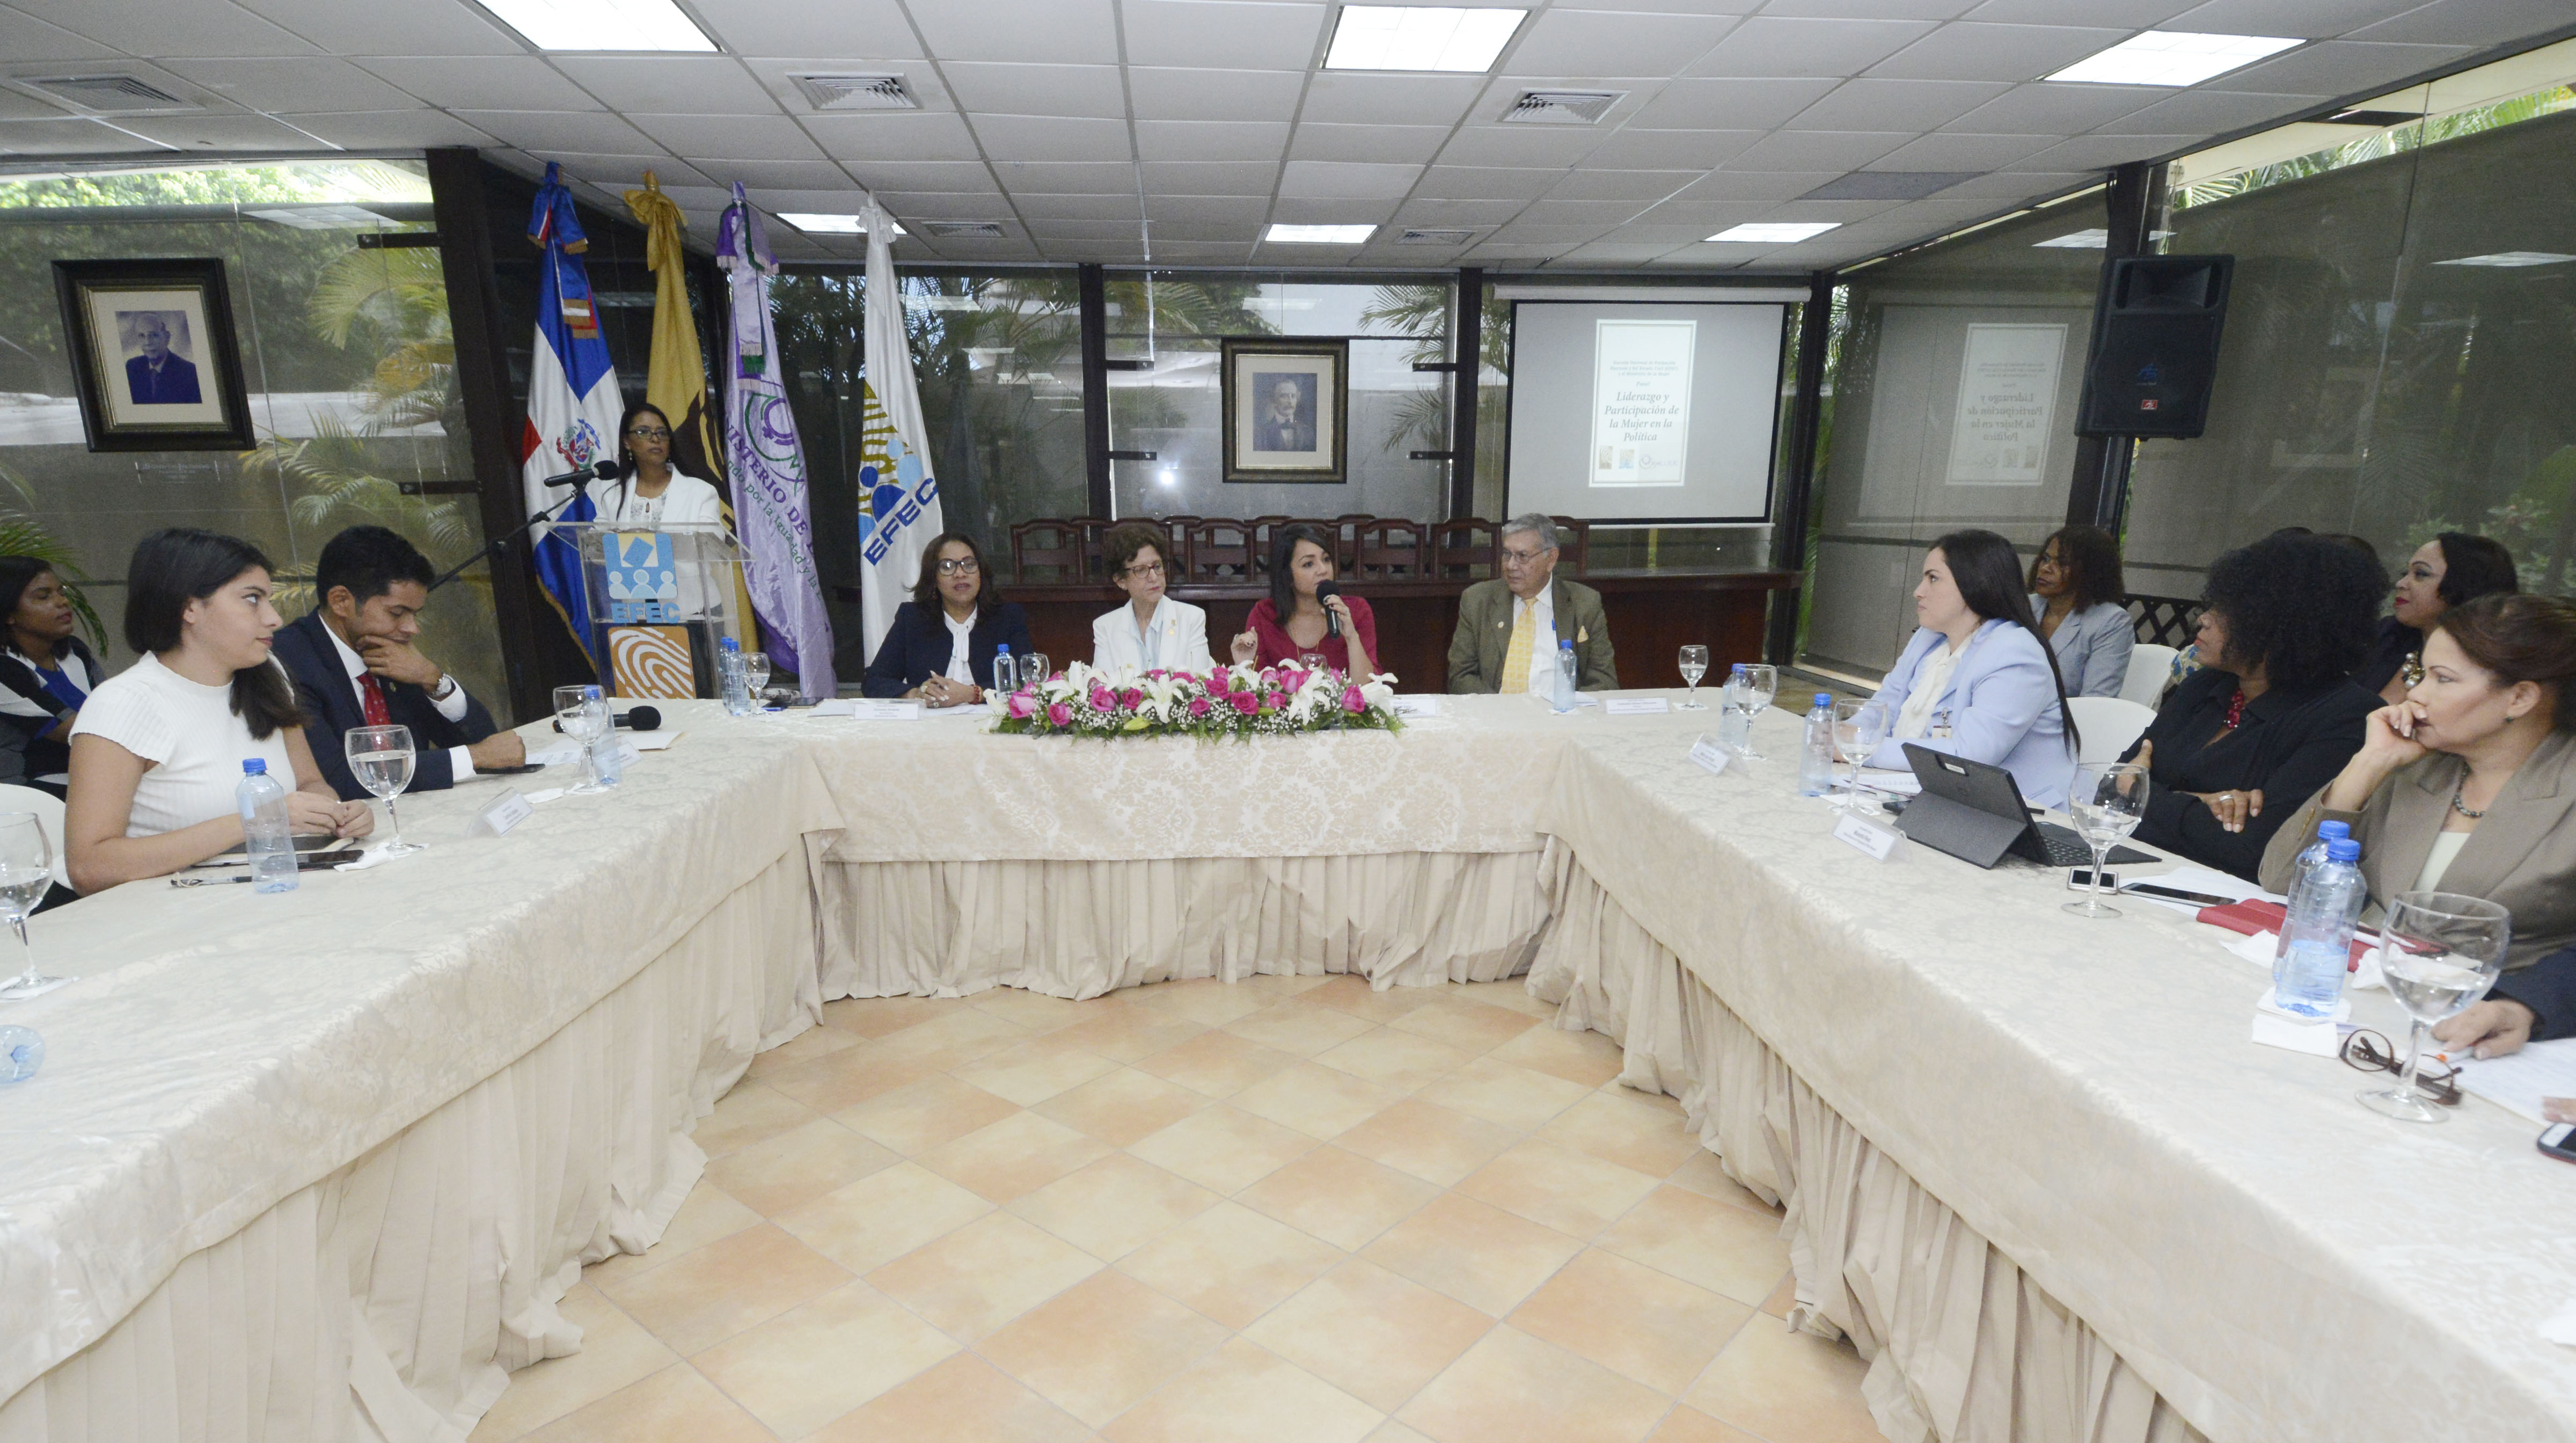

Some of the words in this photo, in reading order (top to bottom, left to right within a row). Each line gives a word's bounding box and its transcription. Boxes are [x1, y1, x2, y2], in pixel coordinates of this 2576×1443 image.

[1616, 391, 1662, 403] Liderazgo
[1663, 393, 1670, 404] y
[1604, 405, 1666, 417] Participación
[1668, 405, 1679, 414] de
[1609, 419, 1619, 428] la
[1621, 419, 1649, 431] Mujer
[1663, 419, 1672, 428] la
[1623, 431, 1657, 441] Política
[743, 483, 764, 504] por
[763, 502, 774, 517] la
[787, 506, 808, 535] DE
[863, 477, 939, 566] EFEC
[611, 602, 680, 624] EFEC
